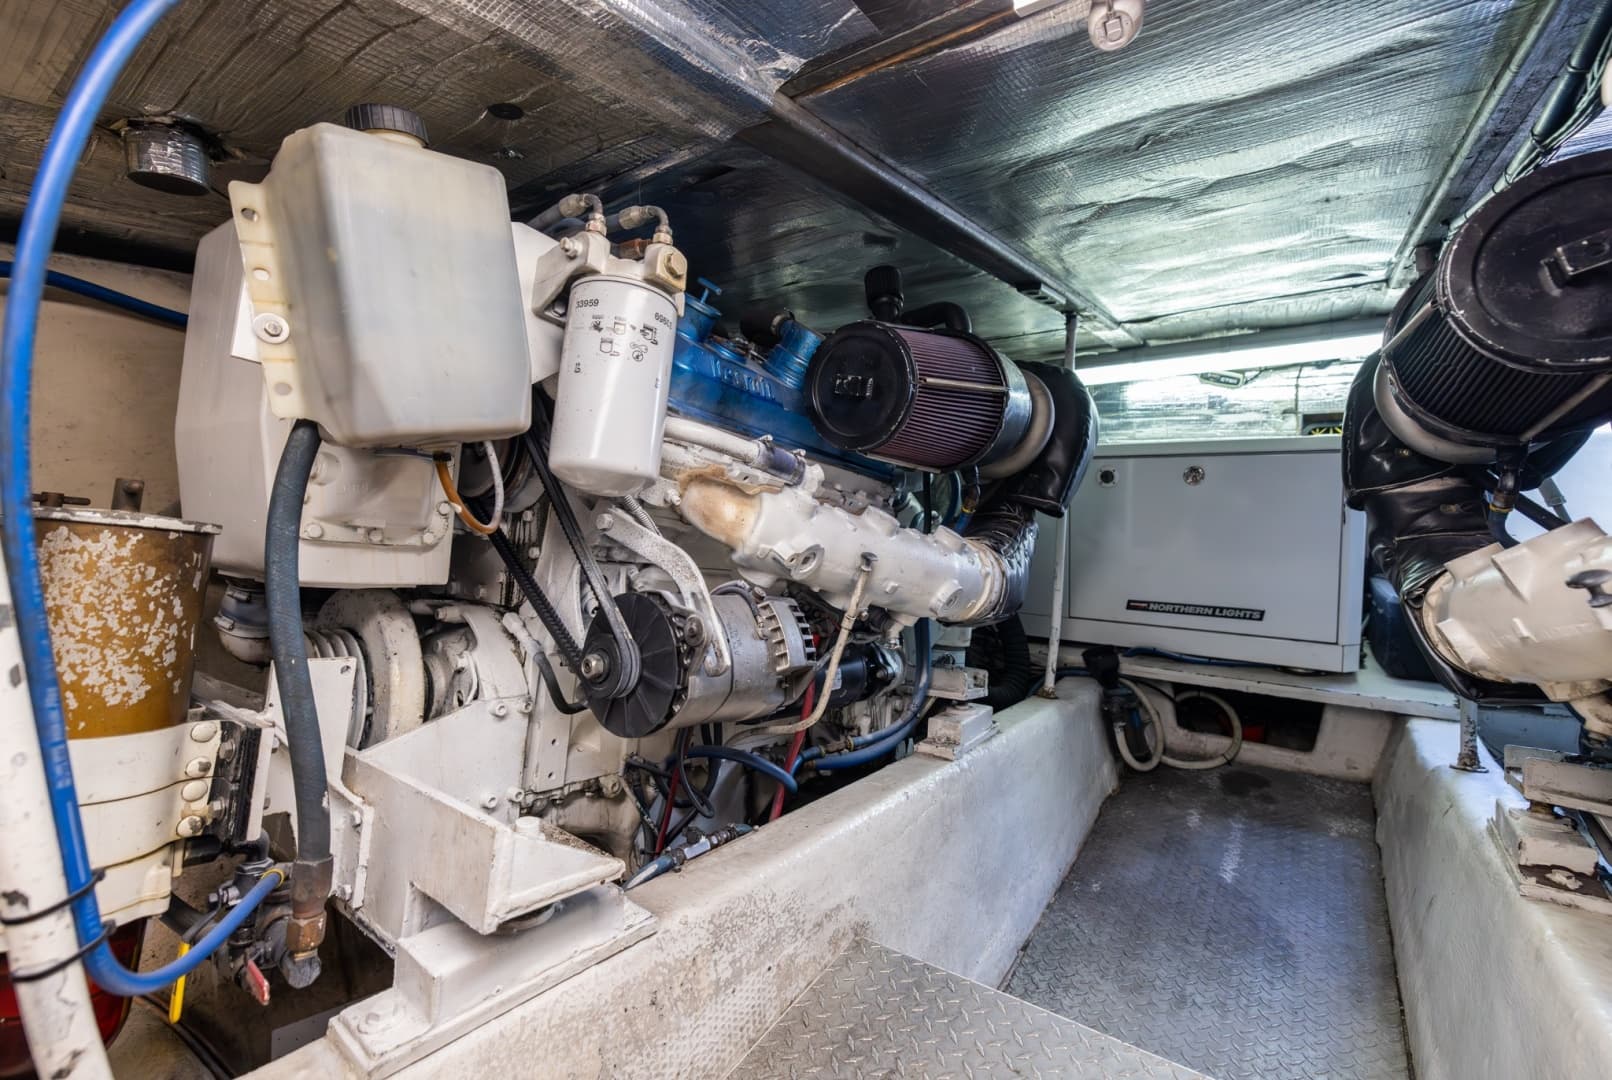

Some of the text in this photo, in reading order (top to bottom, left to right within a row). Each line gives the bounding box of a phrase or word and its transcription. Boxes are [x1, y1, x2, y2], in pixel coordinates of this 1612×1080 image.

[575, 298, 600, 309] 33959
[1148, 602, 1262, 619] NORTHERN LIGHTS
